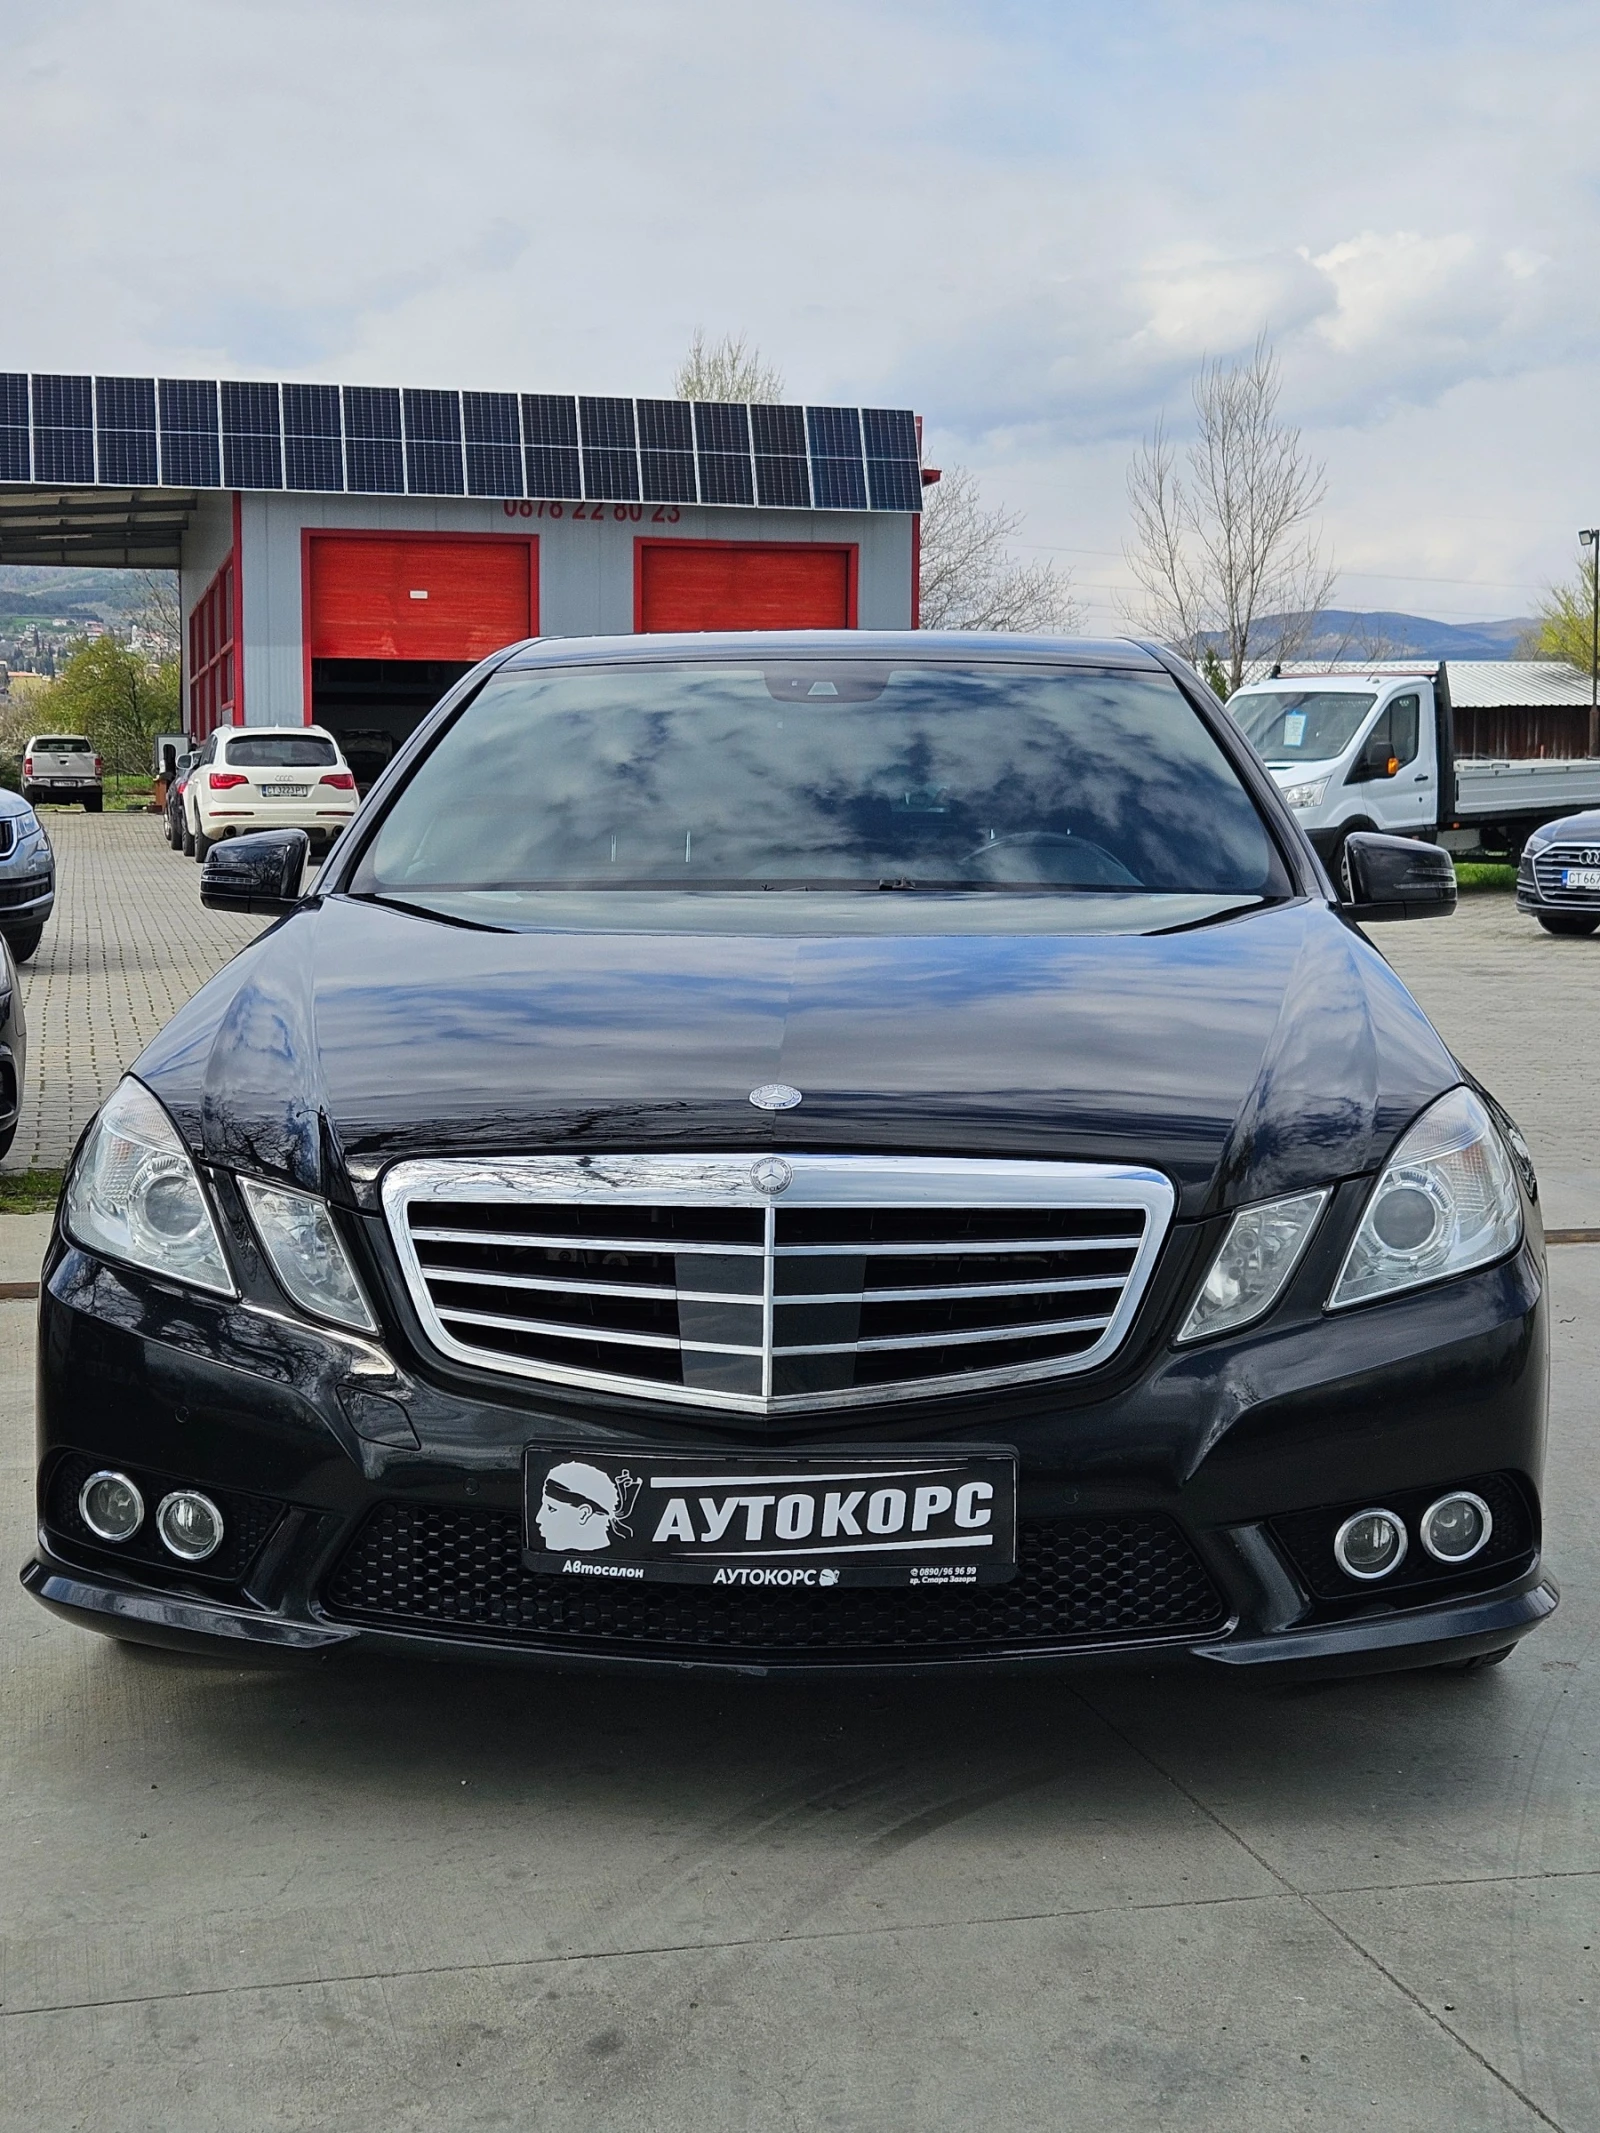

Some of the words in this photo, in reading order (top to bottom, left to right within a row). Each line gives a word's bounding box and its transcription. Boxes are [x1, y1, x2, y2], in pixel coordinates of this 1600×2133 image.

[651, 1481, 994, 1543] АУТОКОРС
[562, 1560, 644, 1579] Автосалон
[712, 1568, 817, 1586] АУТОКОРС
[954, 1567, 965, 1575] 96
[966, 1566, 977, 1575] 99
[921, 1576, 949, 1584] Стара
[949, 1575, 977, 1584] Загора
